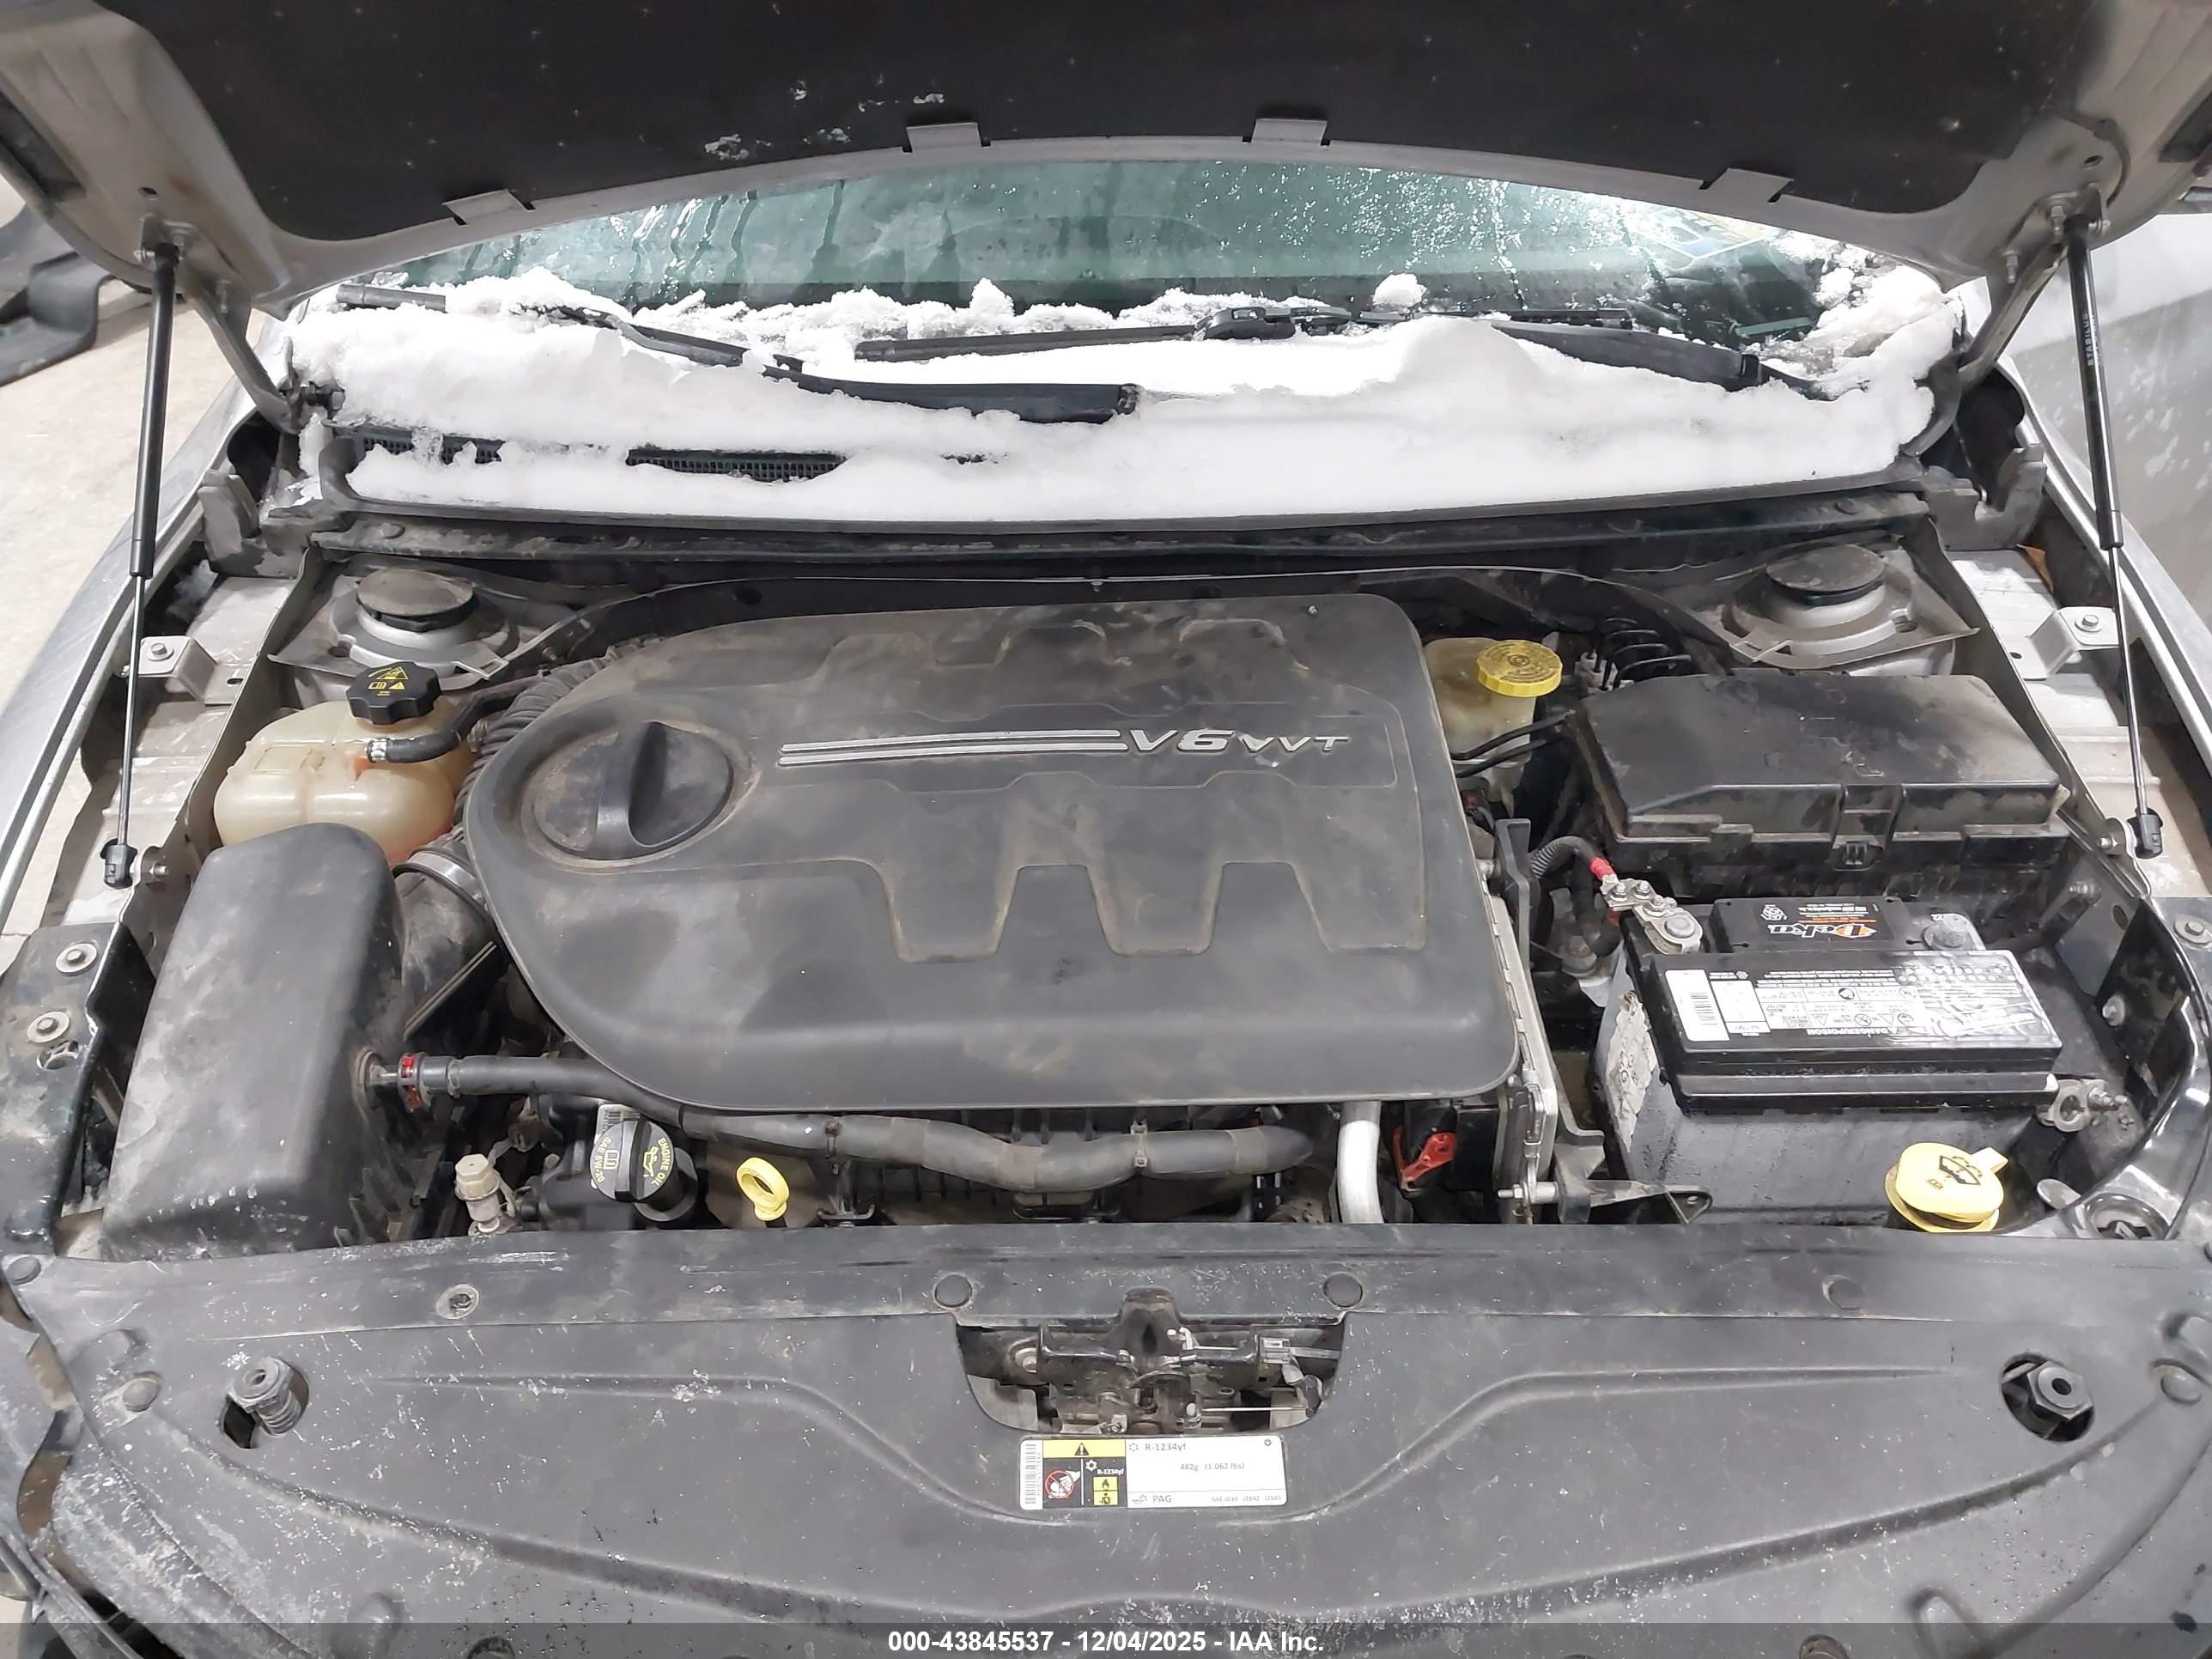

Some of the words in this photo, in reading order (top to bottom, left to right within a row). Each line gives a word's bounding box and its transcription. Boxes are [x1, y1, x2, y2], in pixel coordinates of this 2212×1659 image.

[1128, 728, 1234, 752] V6
[1237, 734, 1350, 753] VVT
[1767, 922, 1878, 939] Deka
[597, 1137, 611, 1152] SAE
[658, 1137, 671, 1173] ENGINE
[650, 1172, 666, 1186] OIL
[1144, 1443, 1187, 1453] R-1234yf
[1179, 1462, 1200, 1472] 482g
[1152, 1494, 1173, 1504] PAG
